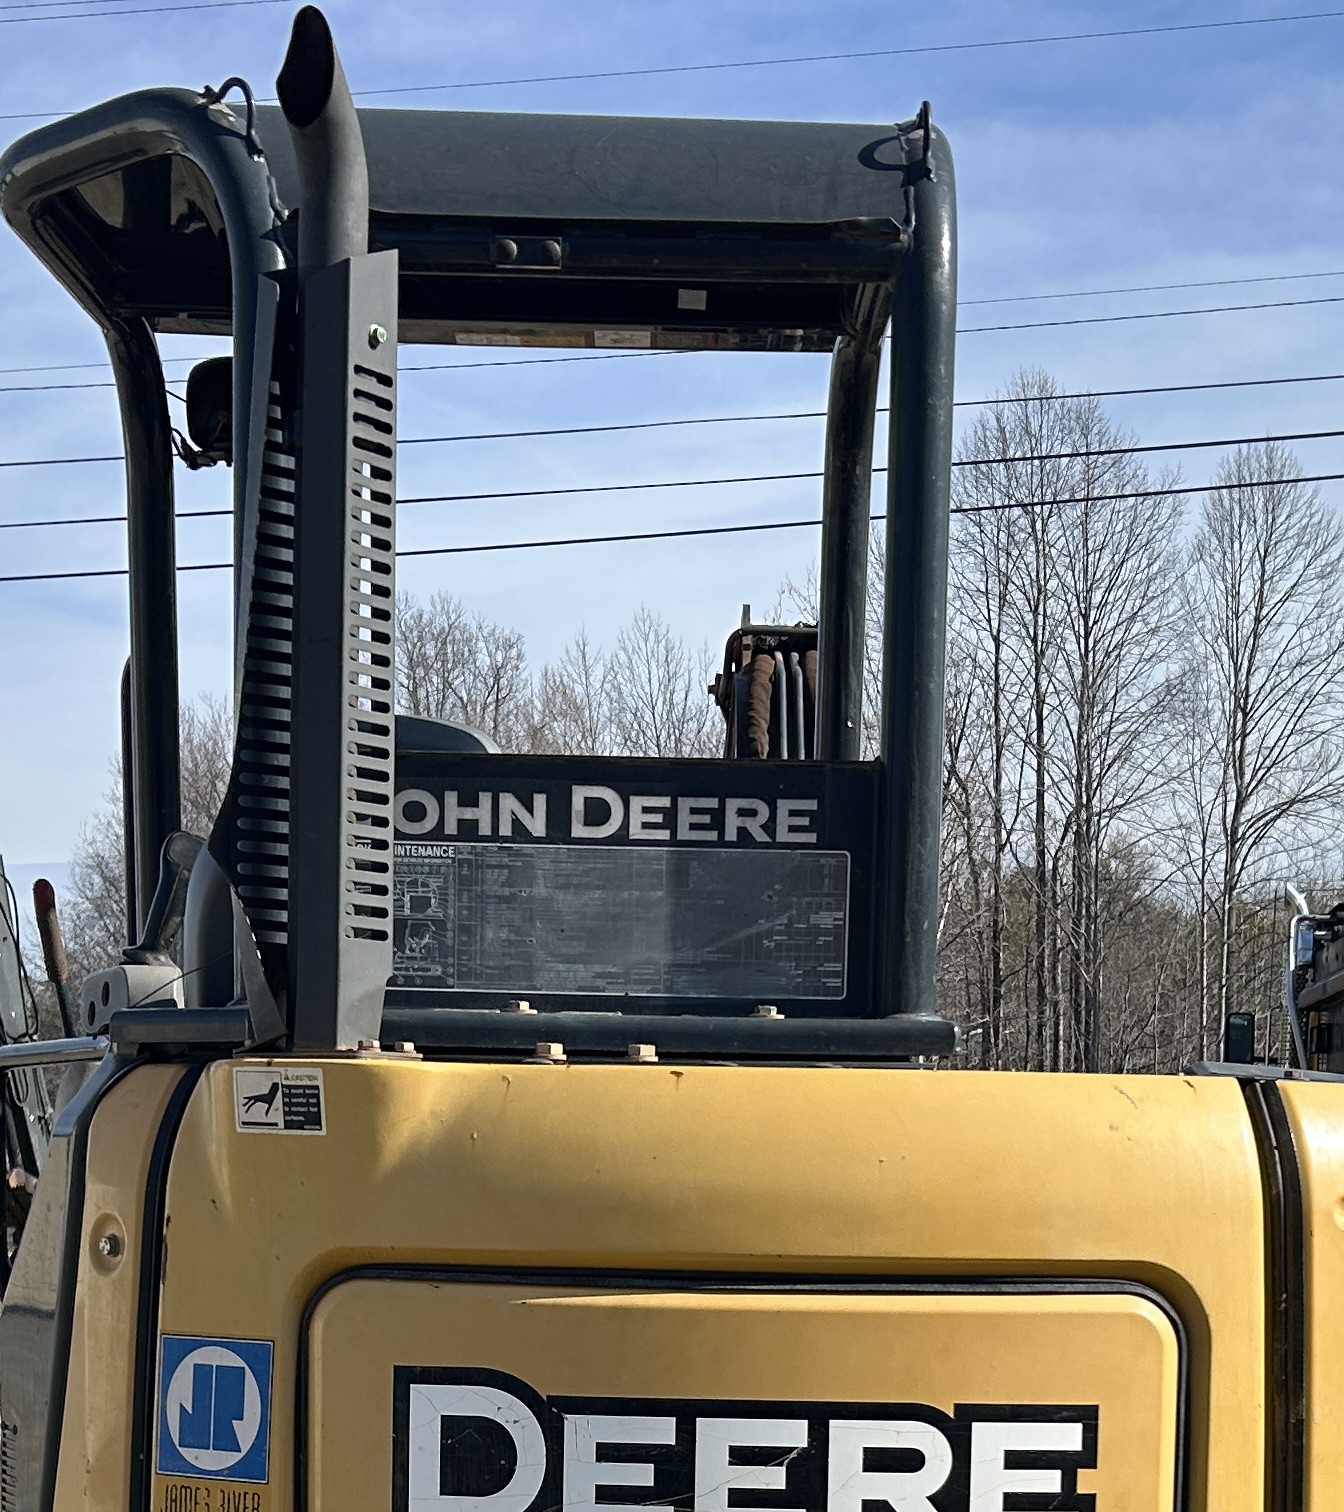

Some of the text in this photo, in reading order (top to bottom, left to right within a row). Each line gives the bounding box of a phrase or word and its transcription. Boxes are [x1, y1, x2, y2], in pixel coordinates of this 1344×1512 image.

[393, 784, 818, 843] OHN DEERE
[394, 844, 456, 859] INTENANCE
